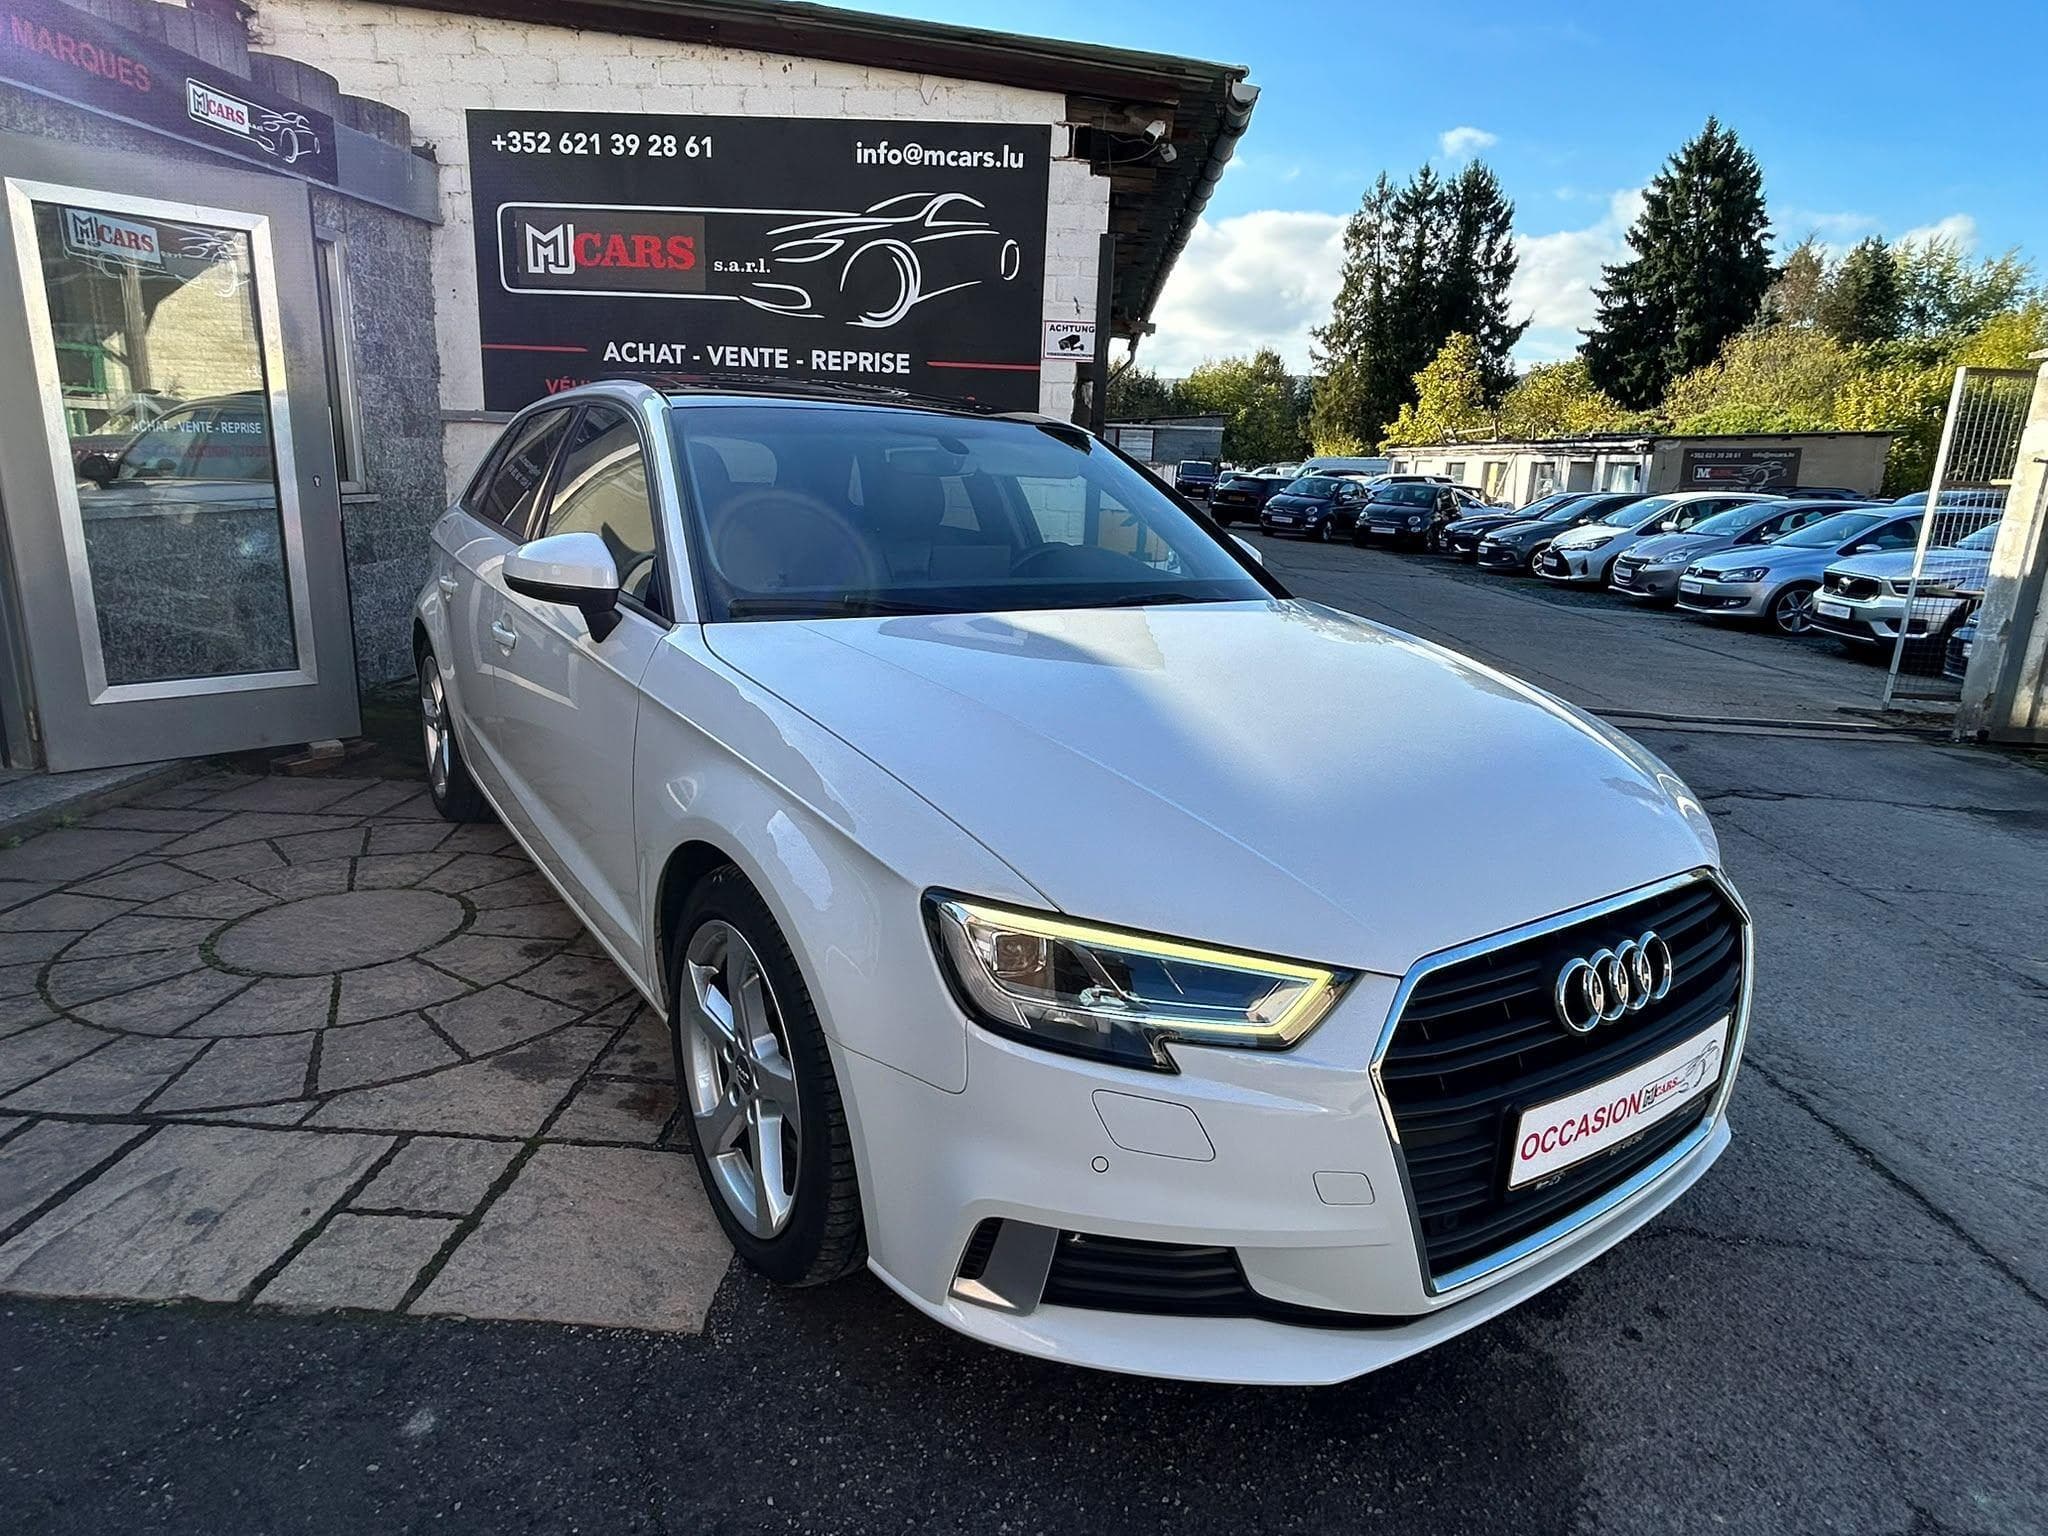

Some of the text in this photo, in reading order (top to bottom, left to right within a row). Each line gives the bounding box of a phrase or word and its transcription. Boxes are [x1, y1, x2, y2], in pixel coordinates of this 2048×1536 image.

[11, 15, 151, 92] MARQUES
[491, 131, 713, 158] +352 621 39 28 61
[856, 141, 1024, 168] info@mcars.lu
[713, 258, 771, 274] s.a.r.l.
[1049, 324, 1095, 333] ACHTUNG
[603, 342, 686, 365] ACHAT
[707, 345, 789, 368] VENTE
[811, 350, 910, 374] REPRISE
[130, 420, 169, 432] ACHAT
[178, 421, 213, 433] VENTE
[221, 422, 262, 434] REPRISE
[1521, 1089, 1642, 1161] OCCASION
